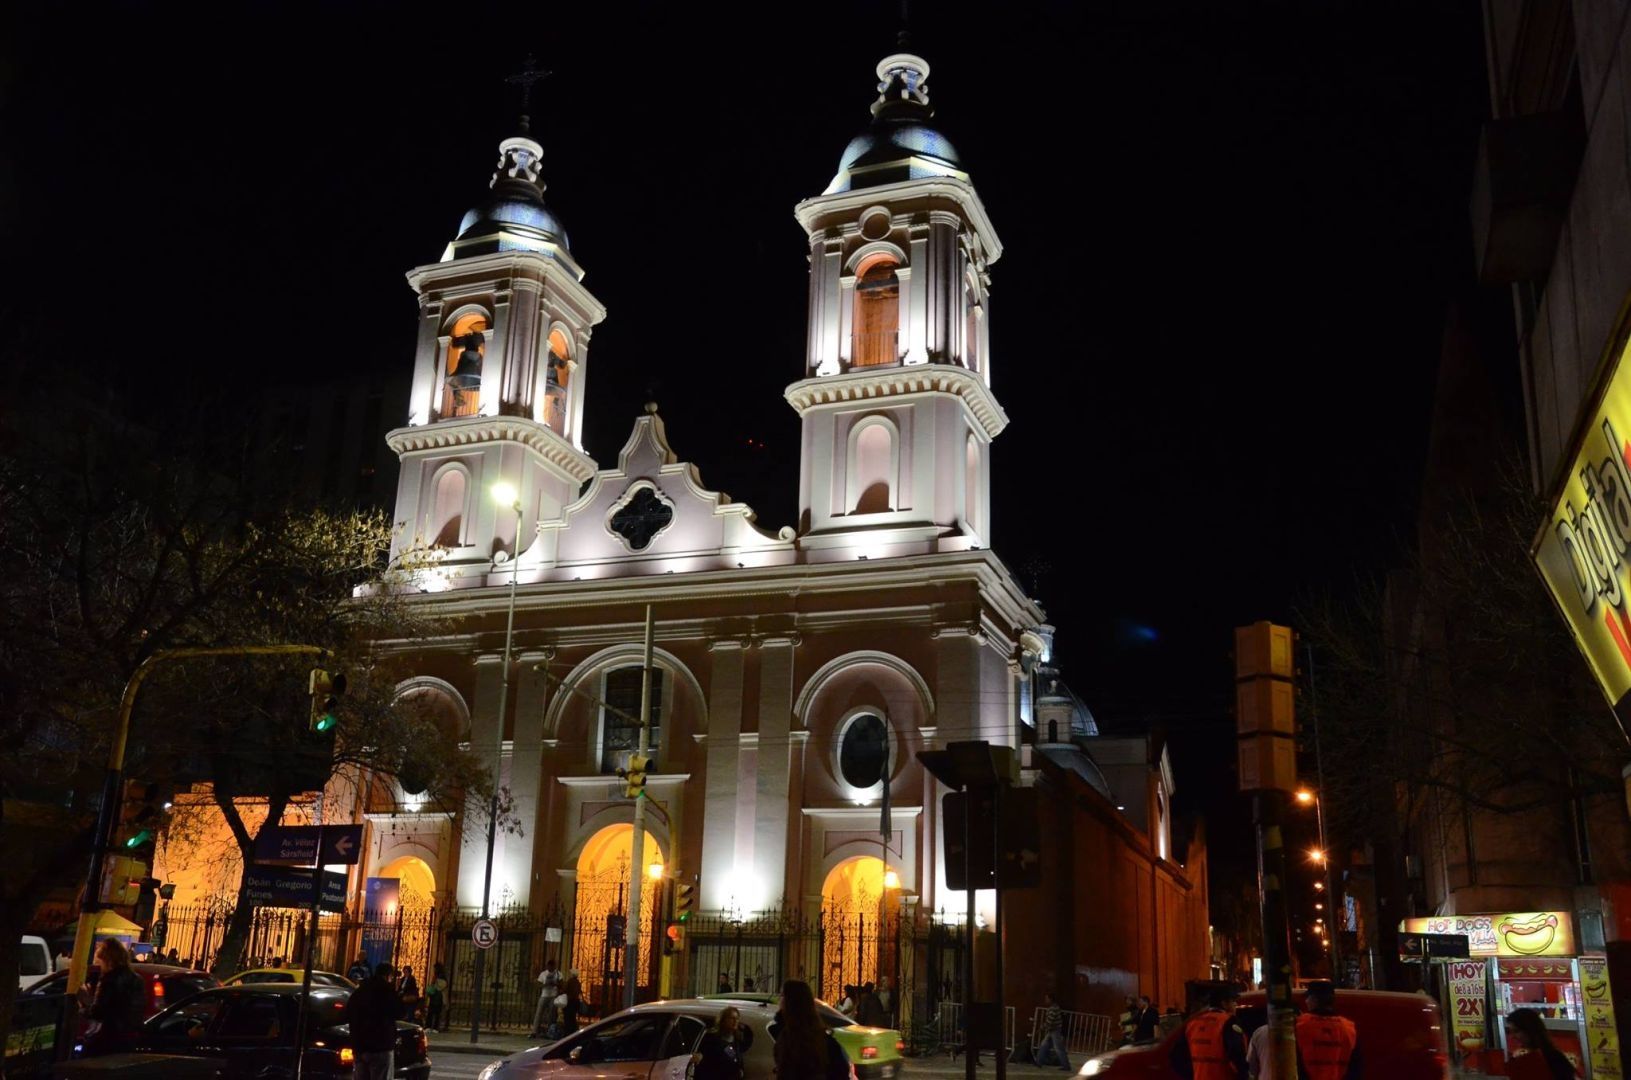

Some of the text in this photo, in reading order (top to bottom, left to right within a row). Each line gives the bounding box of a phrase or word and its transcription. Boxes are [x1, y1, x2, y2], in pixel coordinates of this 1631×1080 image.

[1556, 418, 1631, 613] Digital
[279, 849, 314, 858] Sarsfield
[275, 879, 313, 890] Gregorio
[246, 888, 273, 899] Funes
[1428, 917, 1491, 932] HOT DOGS
